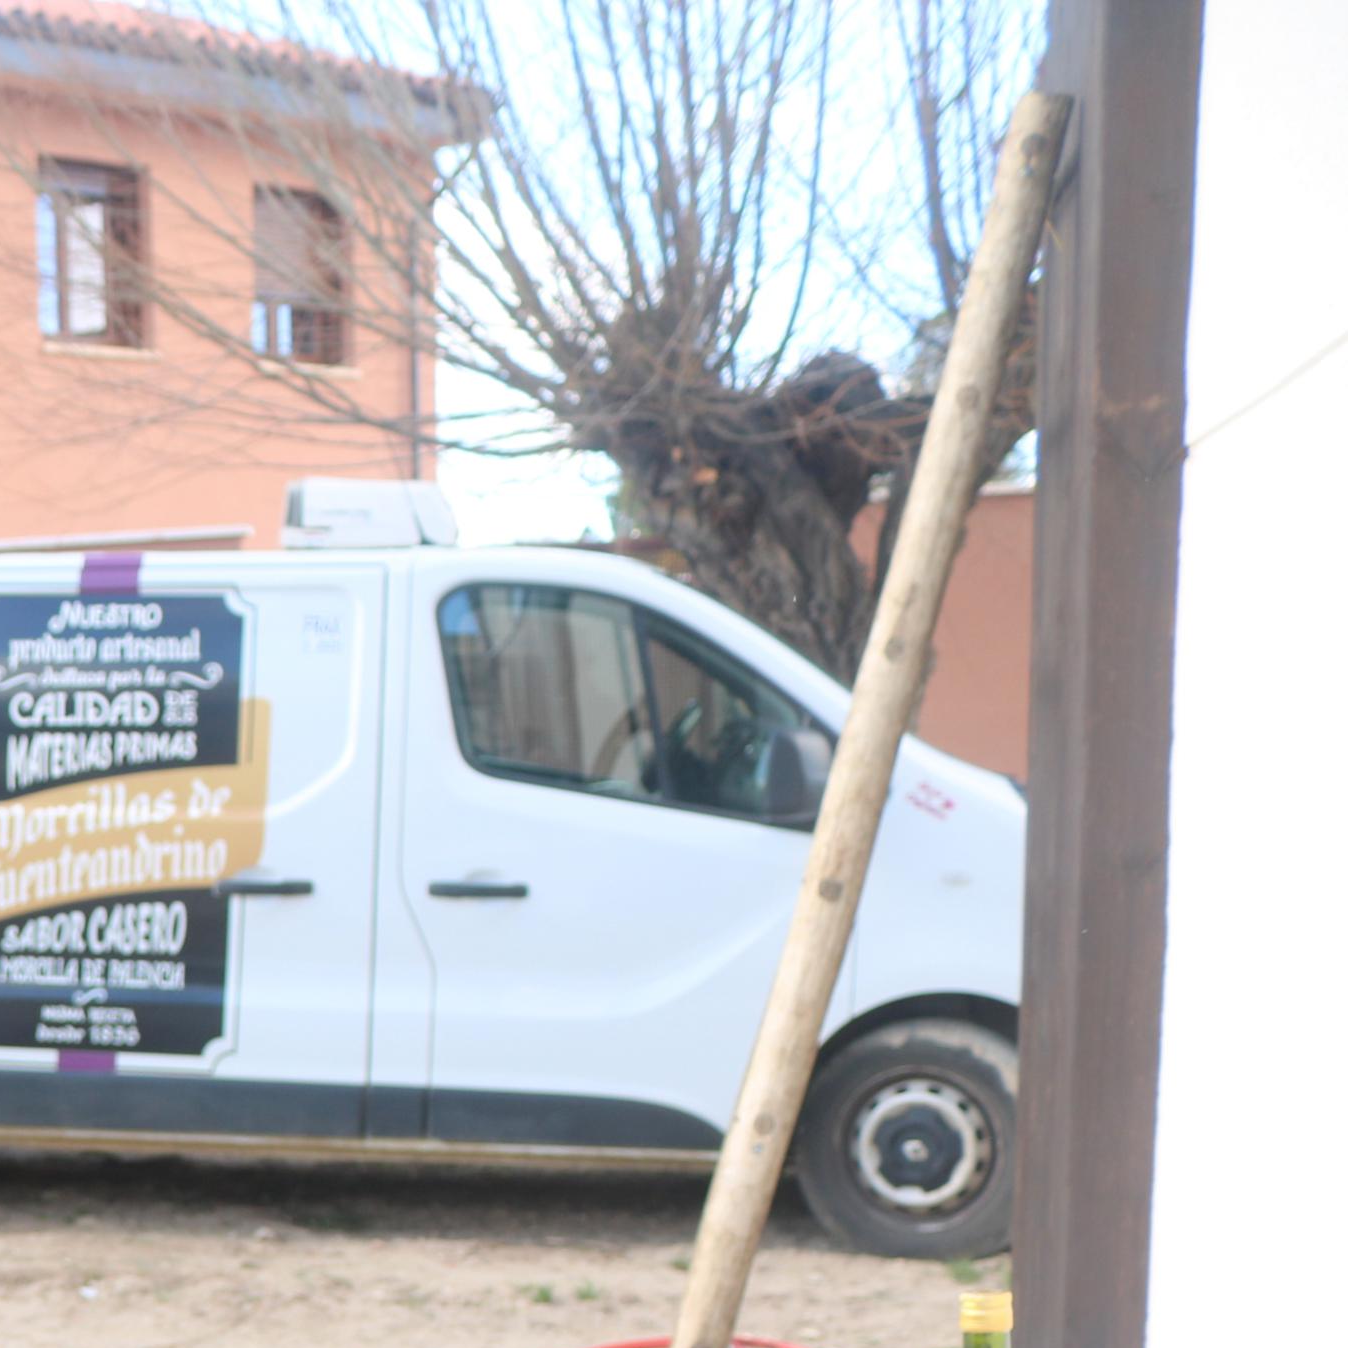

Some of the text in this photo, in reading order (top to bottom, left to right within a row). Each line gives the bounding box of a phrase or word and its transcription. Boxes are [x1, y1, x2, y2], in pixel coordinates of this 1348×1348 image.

[48, 601, 162, 633] NUESTRO
[99, 629, 201, 662] artesanal
[8, 689, 198, 727] CALIDAD DE
[6, 730, 198, 791] MATERIAS PRIMAS
[186, 777, 232, 819] de
[0, 900, 188, 955] SABOR CASERO
